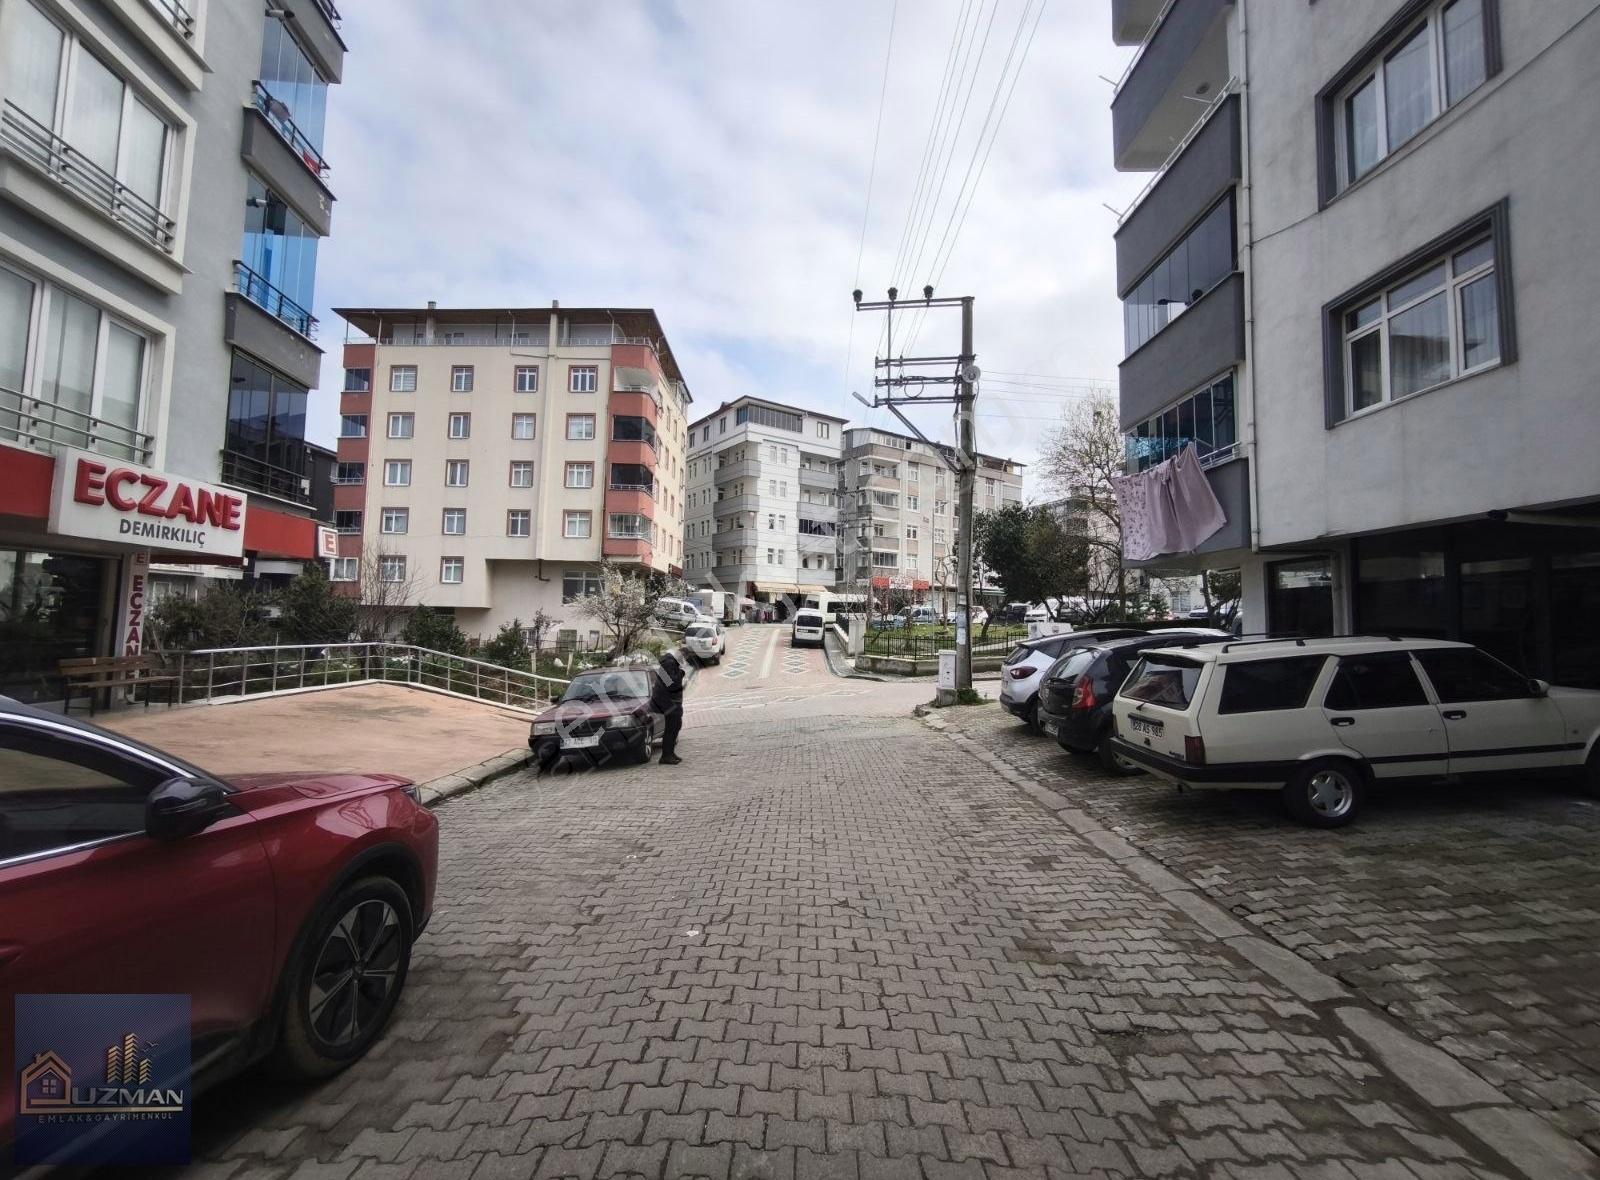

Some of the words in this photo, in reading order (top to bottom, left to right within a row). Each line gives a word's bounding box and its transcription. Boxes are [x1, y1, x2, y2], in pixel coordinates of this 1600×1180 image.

[74, 458, 243, 531] ECZANE
[119, 518, 206, 549] DEMİRKILIÇ
[325, 533, 336, 553] E
